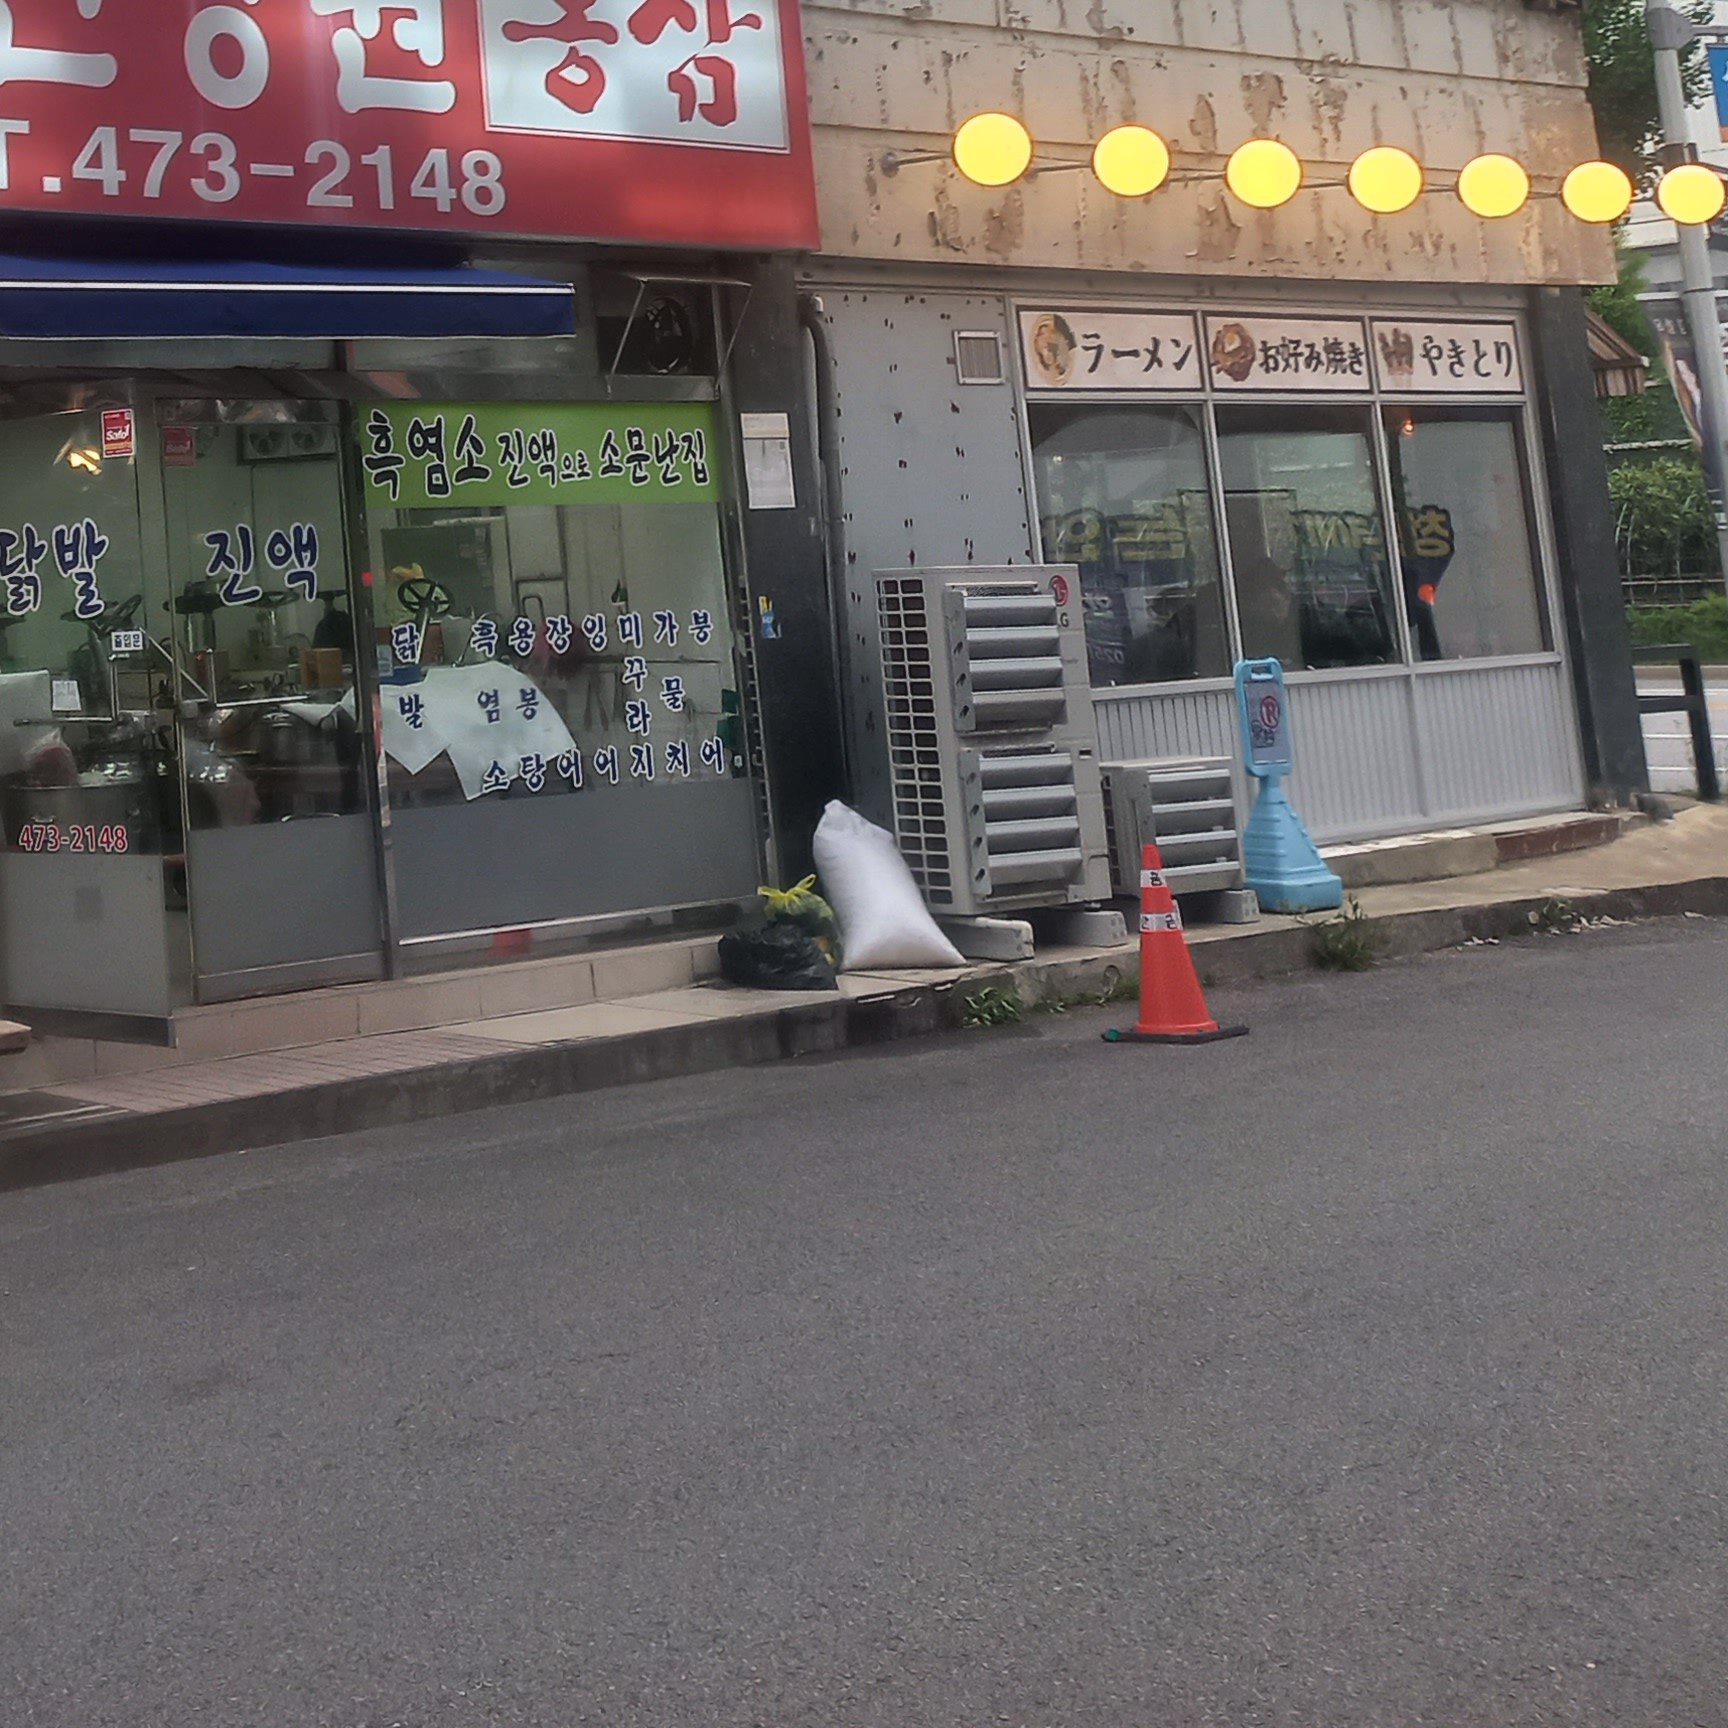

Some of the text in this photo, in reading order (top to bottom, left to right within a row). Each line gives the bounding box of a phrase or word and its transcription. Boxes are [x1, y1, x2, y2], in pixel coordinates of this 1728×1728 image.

[1079, 332, 1193, 374] ラーメン
[1258, 336, 1365, 377] お好み焼き
[1419, 334, 1515, 378] やきとり
[363, 408, 492, 501] 흑염소
[597, 427, 711, 488] 소문난집
[204, 522, 319, 606] 진액
[18, 823, 129, 854] 473-2148
